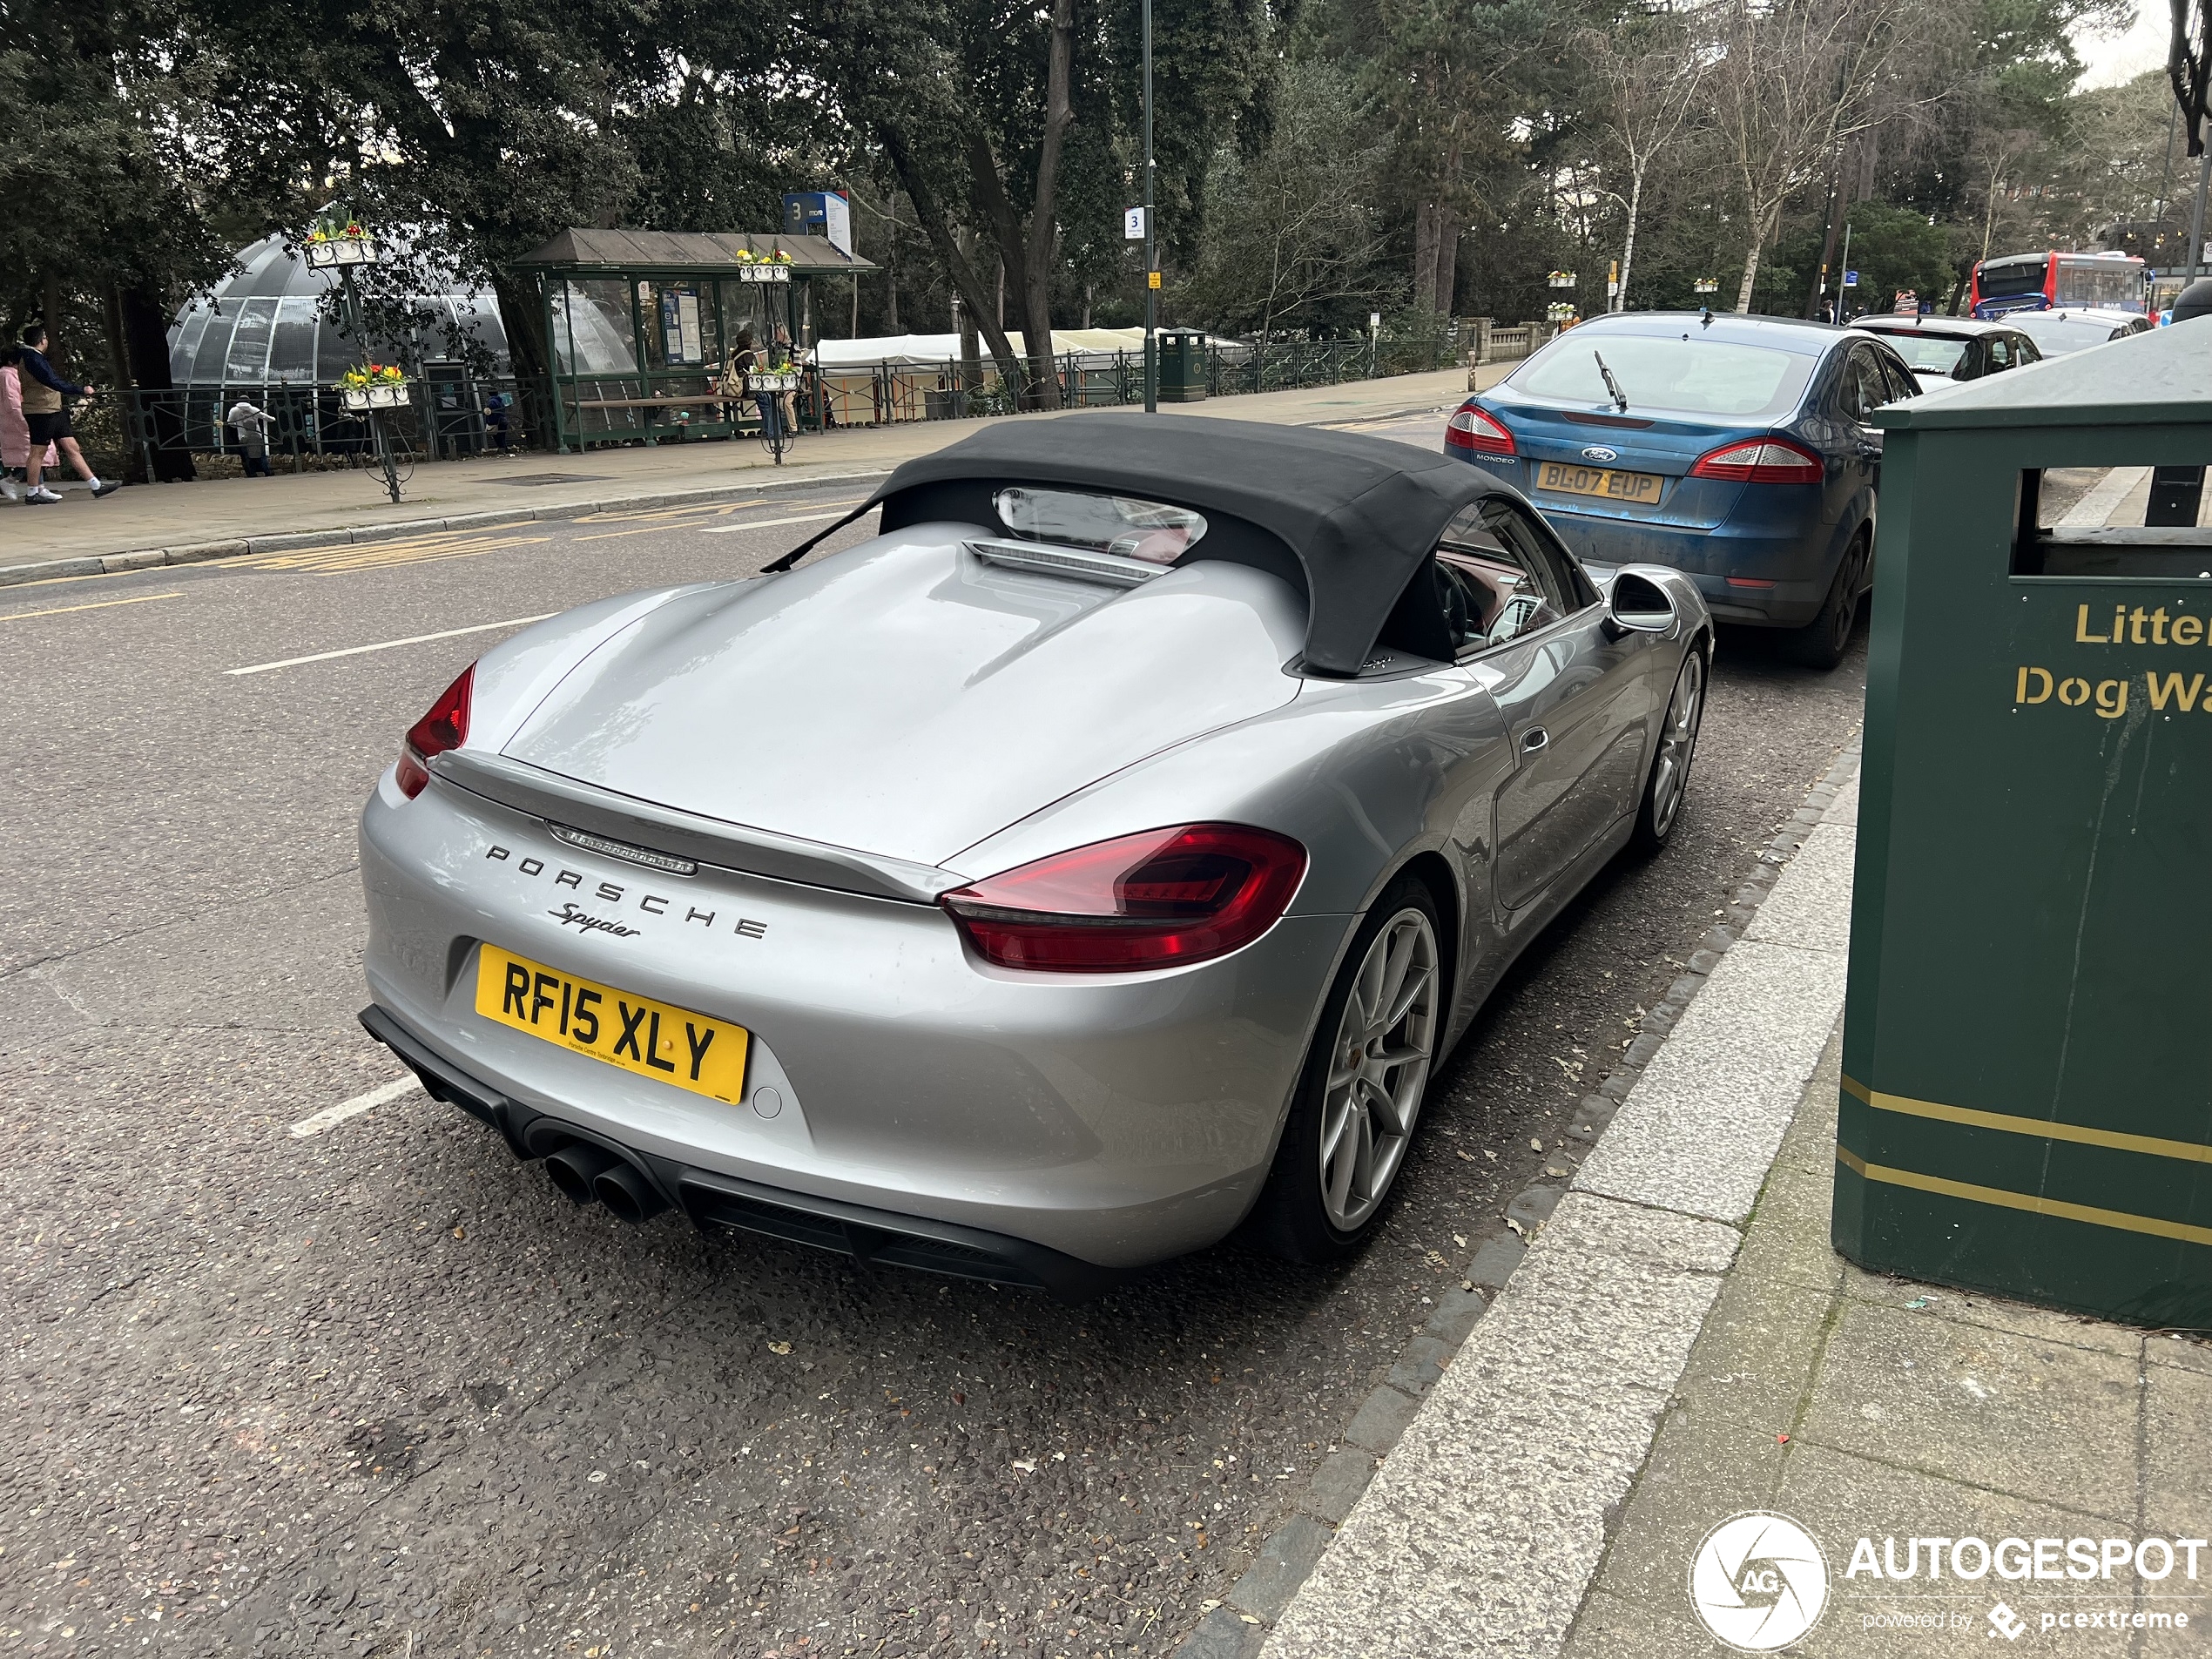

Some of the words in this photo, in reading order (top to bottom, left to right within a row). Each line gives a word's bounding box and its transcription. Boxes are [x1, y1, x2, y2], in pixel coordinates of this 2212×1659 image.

[792, 202, 801, 220] 3
[1131, 216, 1138, 227] 3
[1476, 454, 1515, 464] MONDEO
[1587, 448, 1613, 460] Ford
[1545, 466, 1603, 492] BL07
[1608, 473, 1653, 497] EUP
[2015, 666, 2129, 718] Dog
[485, 845, 767, 940] PORSCHE
[548, 902, 641, 934] Spyder
[502, 961, 603, 1045] RF15
[613, 1001, 715, 1082] XLY
[568, 1041, 583, 1052] Porsche
[583, 1047, 597, 1056] Centre
